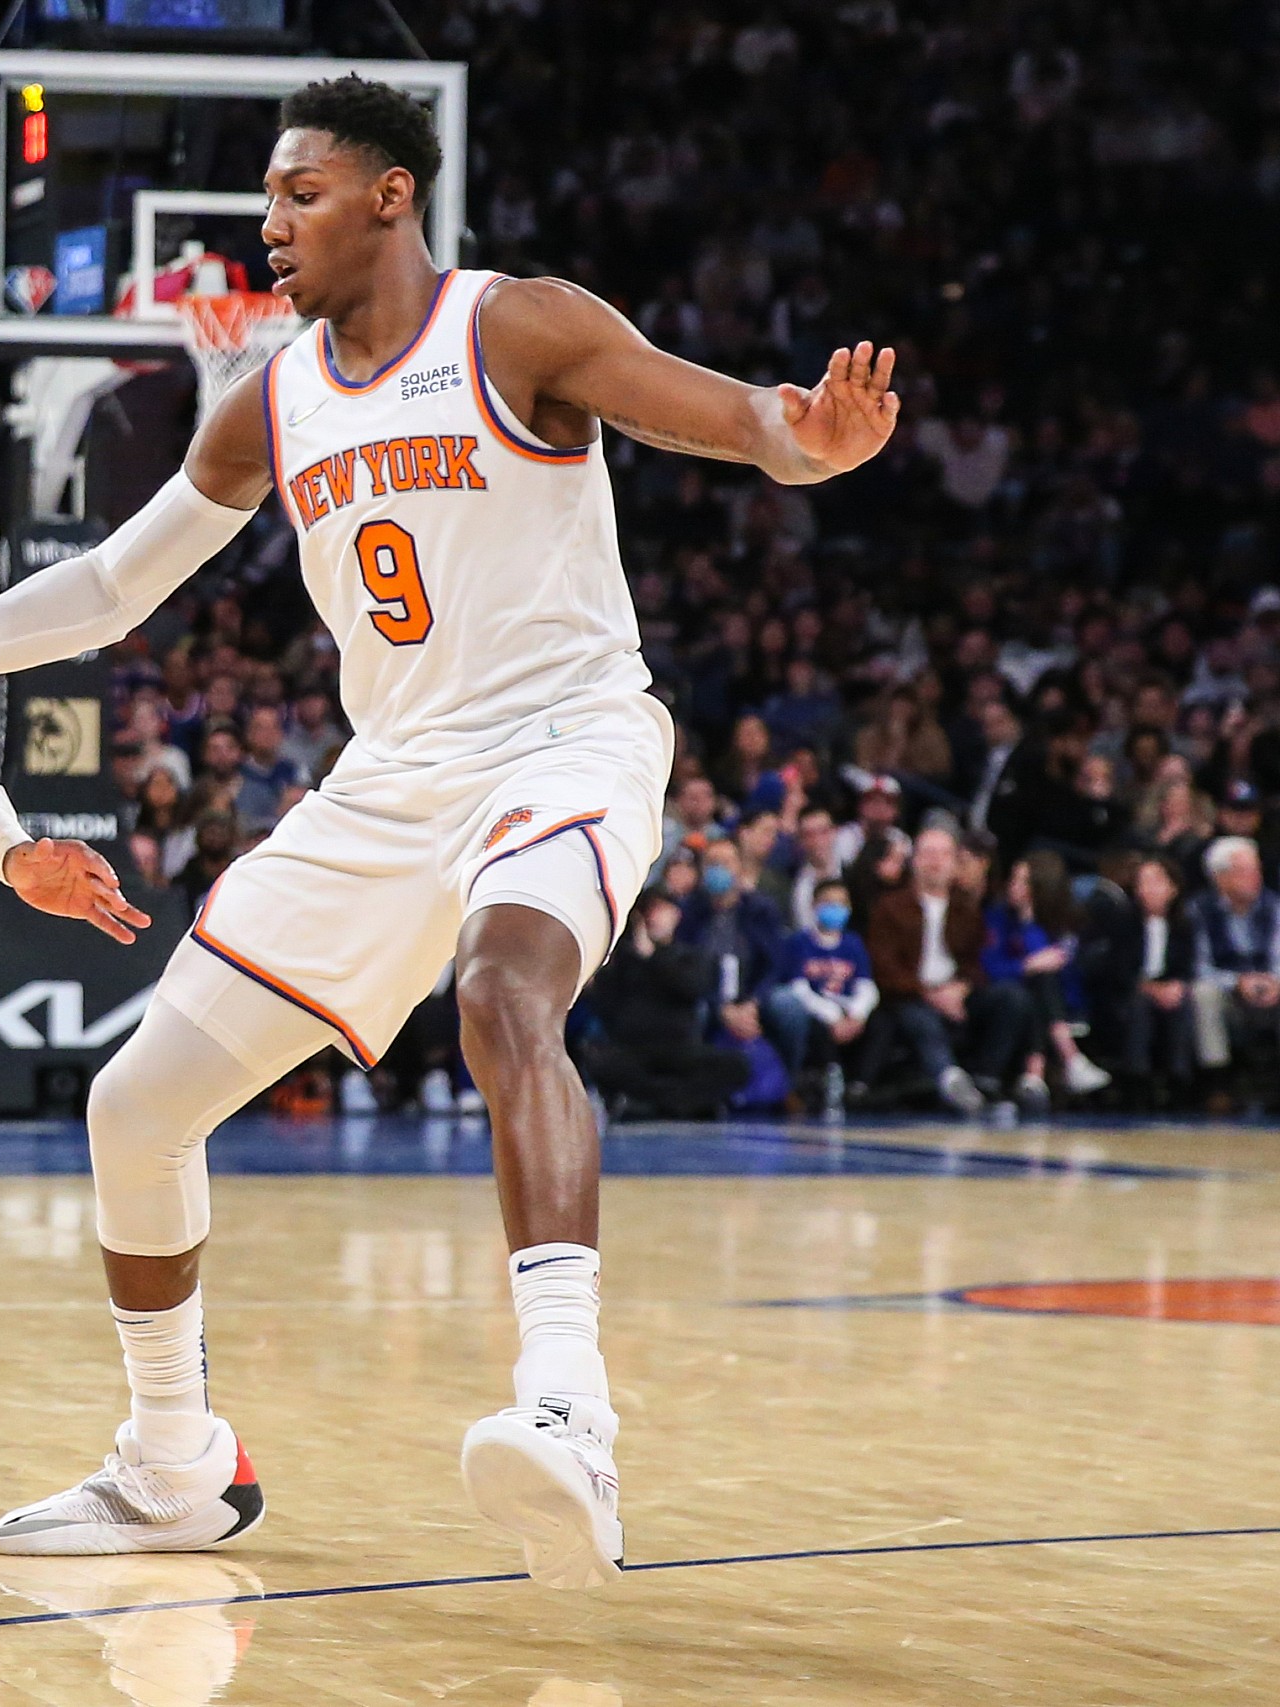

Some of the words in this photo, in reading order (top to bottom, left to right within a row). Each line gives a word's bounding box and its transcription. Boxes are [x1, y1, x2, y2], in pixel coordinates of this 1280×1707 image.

[400, 363, 460, 388] SQUARE
[401, 379, 449, 401] SPACE
[289, 446, 356, 532] NEW
[359, 434, 487, 497] YORK
[354, 518, 435, 647] 9
